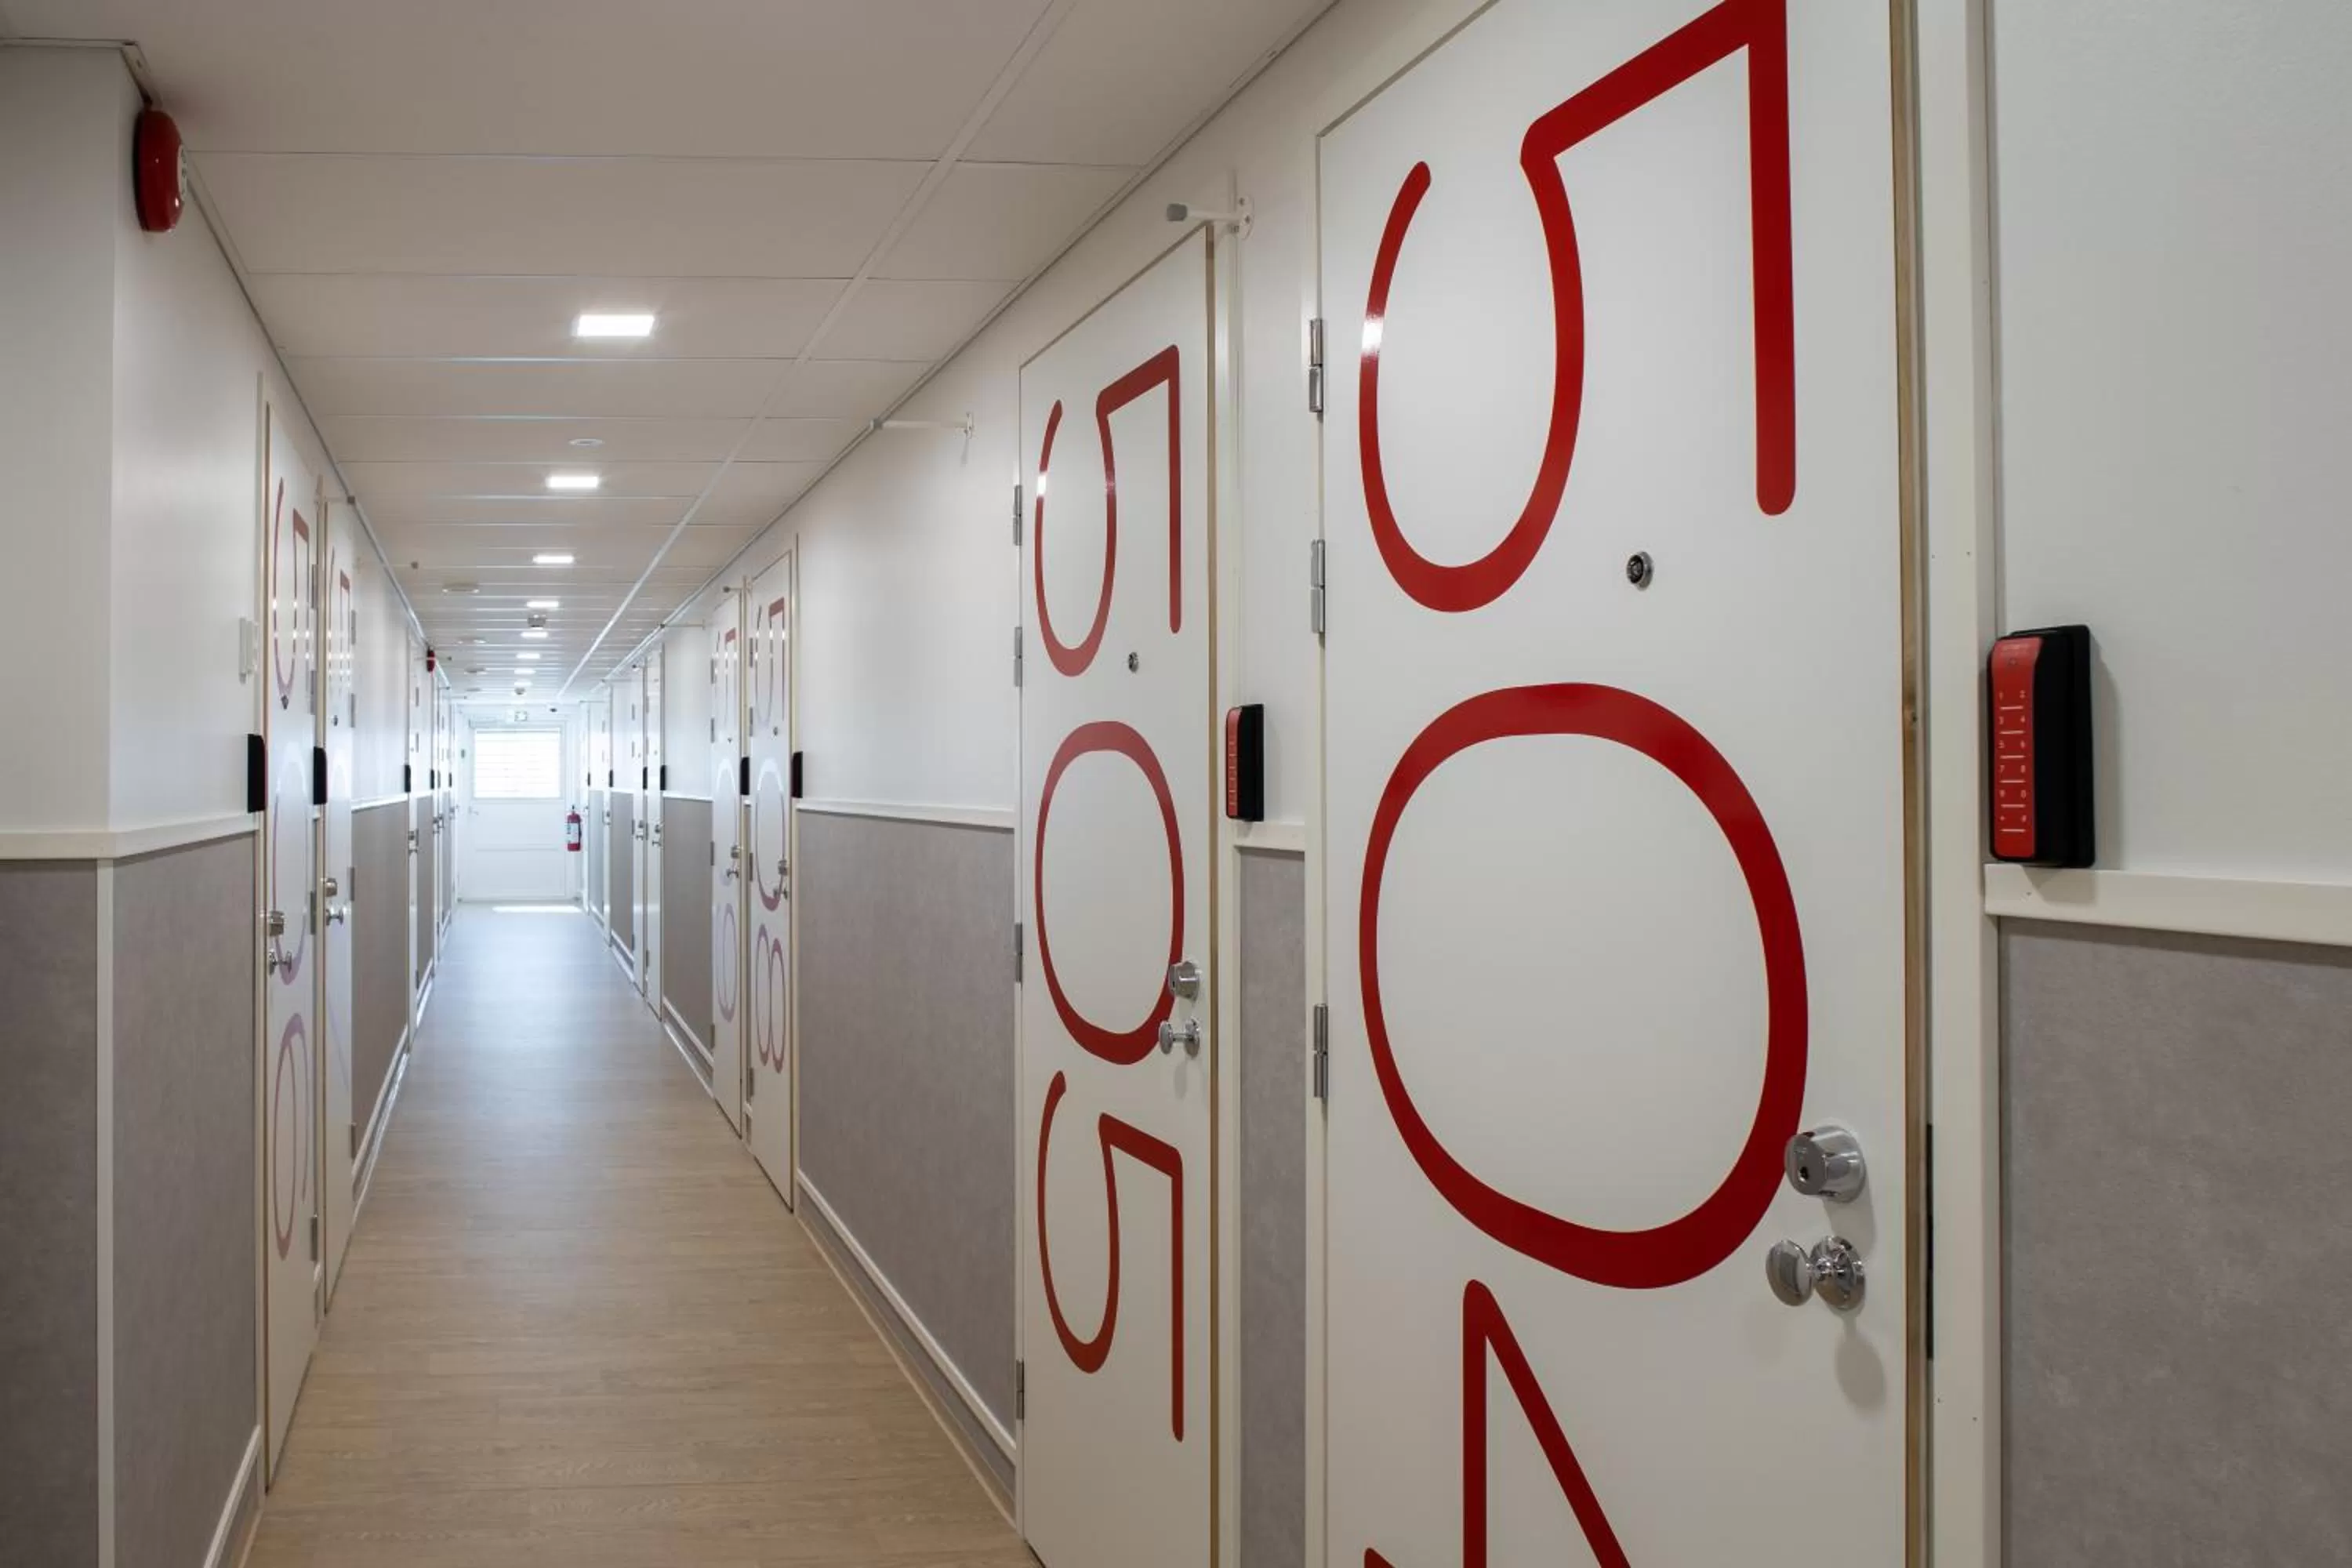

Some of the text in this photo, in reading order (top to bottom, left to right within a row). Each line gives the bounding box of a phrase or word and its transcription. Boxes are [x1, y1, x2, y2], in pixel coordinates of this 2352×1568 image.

[272, 477, 310, 1261] 506
[754, 597, 786, 1074] 508
[1036, 344, 1185, 1443] 505
